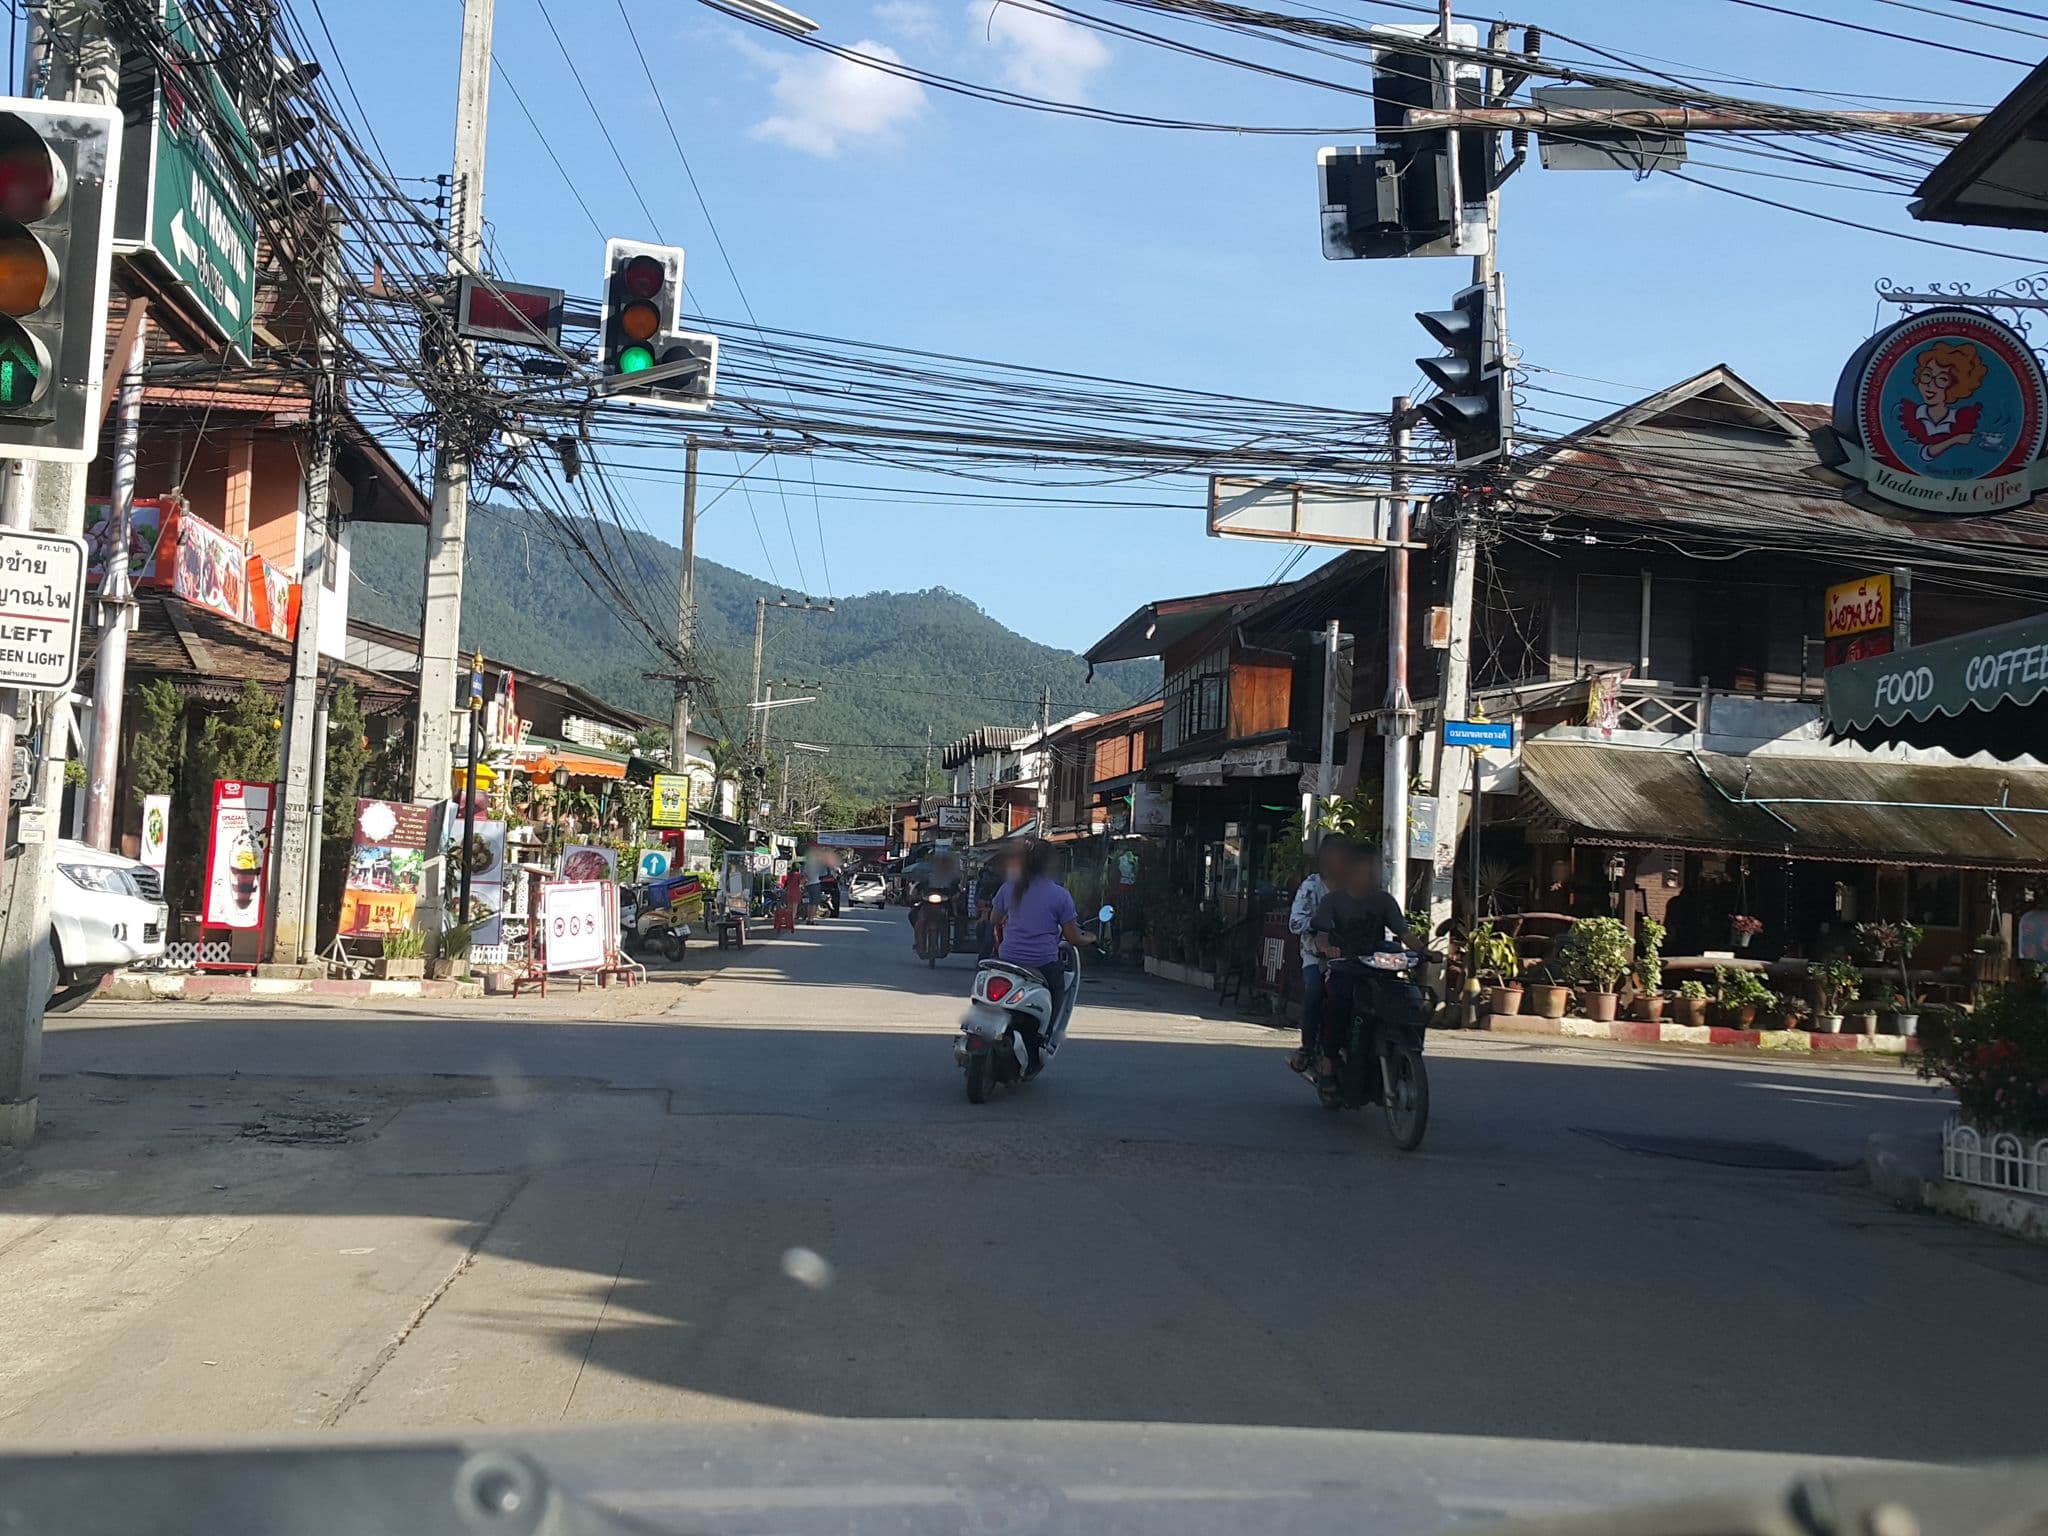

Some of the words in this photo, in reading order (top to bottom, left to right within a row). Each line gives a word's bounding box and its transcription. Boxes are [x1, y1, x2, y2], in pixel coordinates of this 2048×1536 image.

[191, 170, 207, 228] PAI
[208, 195, 247, 285] HOSPITAL
[1872, 469, 1944, 501] Madame
[1946, 486, 1968, 502] Ju
[1972, 480, 2023, 505] Coffee
[1, 624, 53, 644] LEFT
[27, 651, 65, 667] LIGHT
[1874, 666, 1935, 709] FOOD
